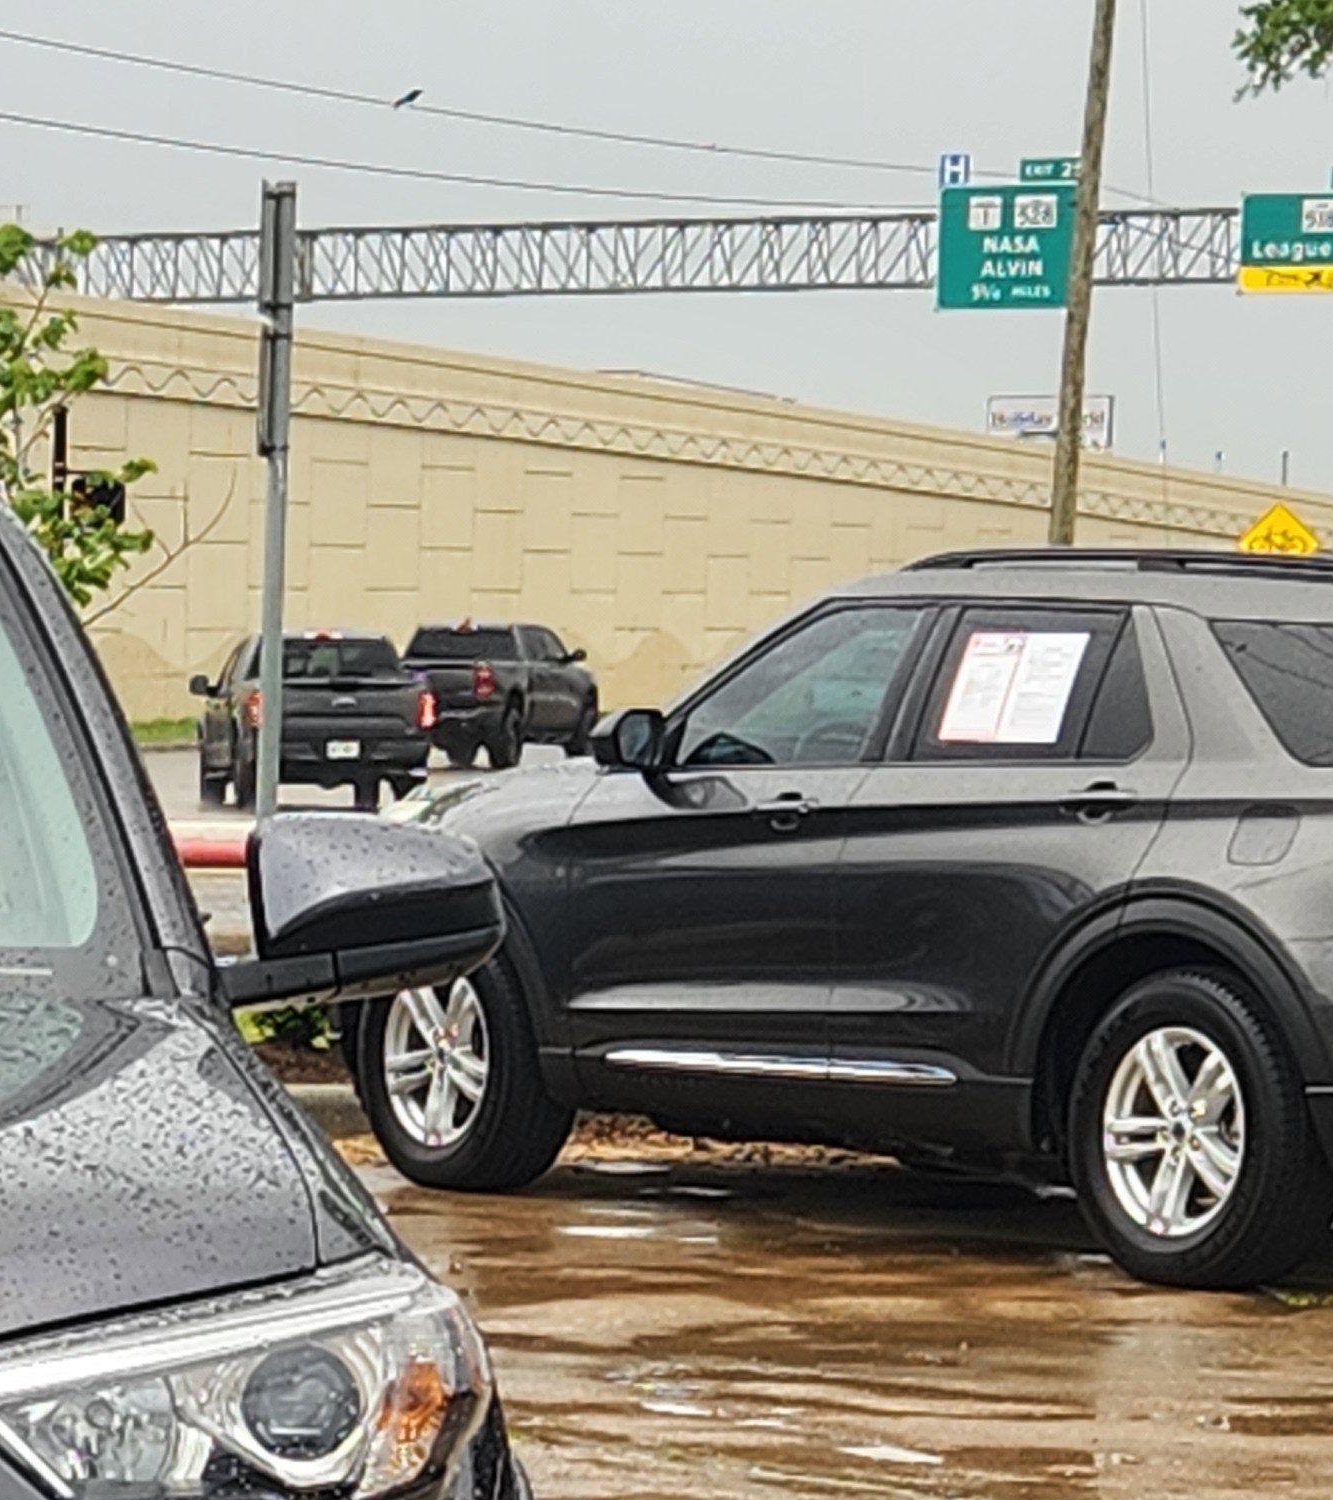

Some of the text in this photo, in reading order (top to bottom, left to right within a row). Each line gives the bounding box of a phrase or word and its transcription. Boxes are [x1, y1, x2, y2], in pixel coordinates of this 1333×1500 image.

[1024, 163, 1054, 177] EXIT
[982, 235, 1041, 253] NASA
[1252, 240, 1332, 262] League
[980, 260, 1044, 278] ALVIN
[1010, 285, 1052, 298] MILES
